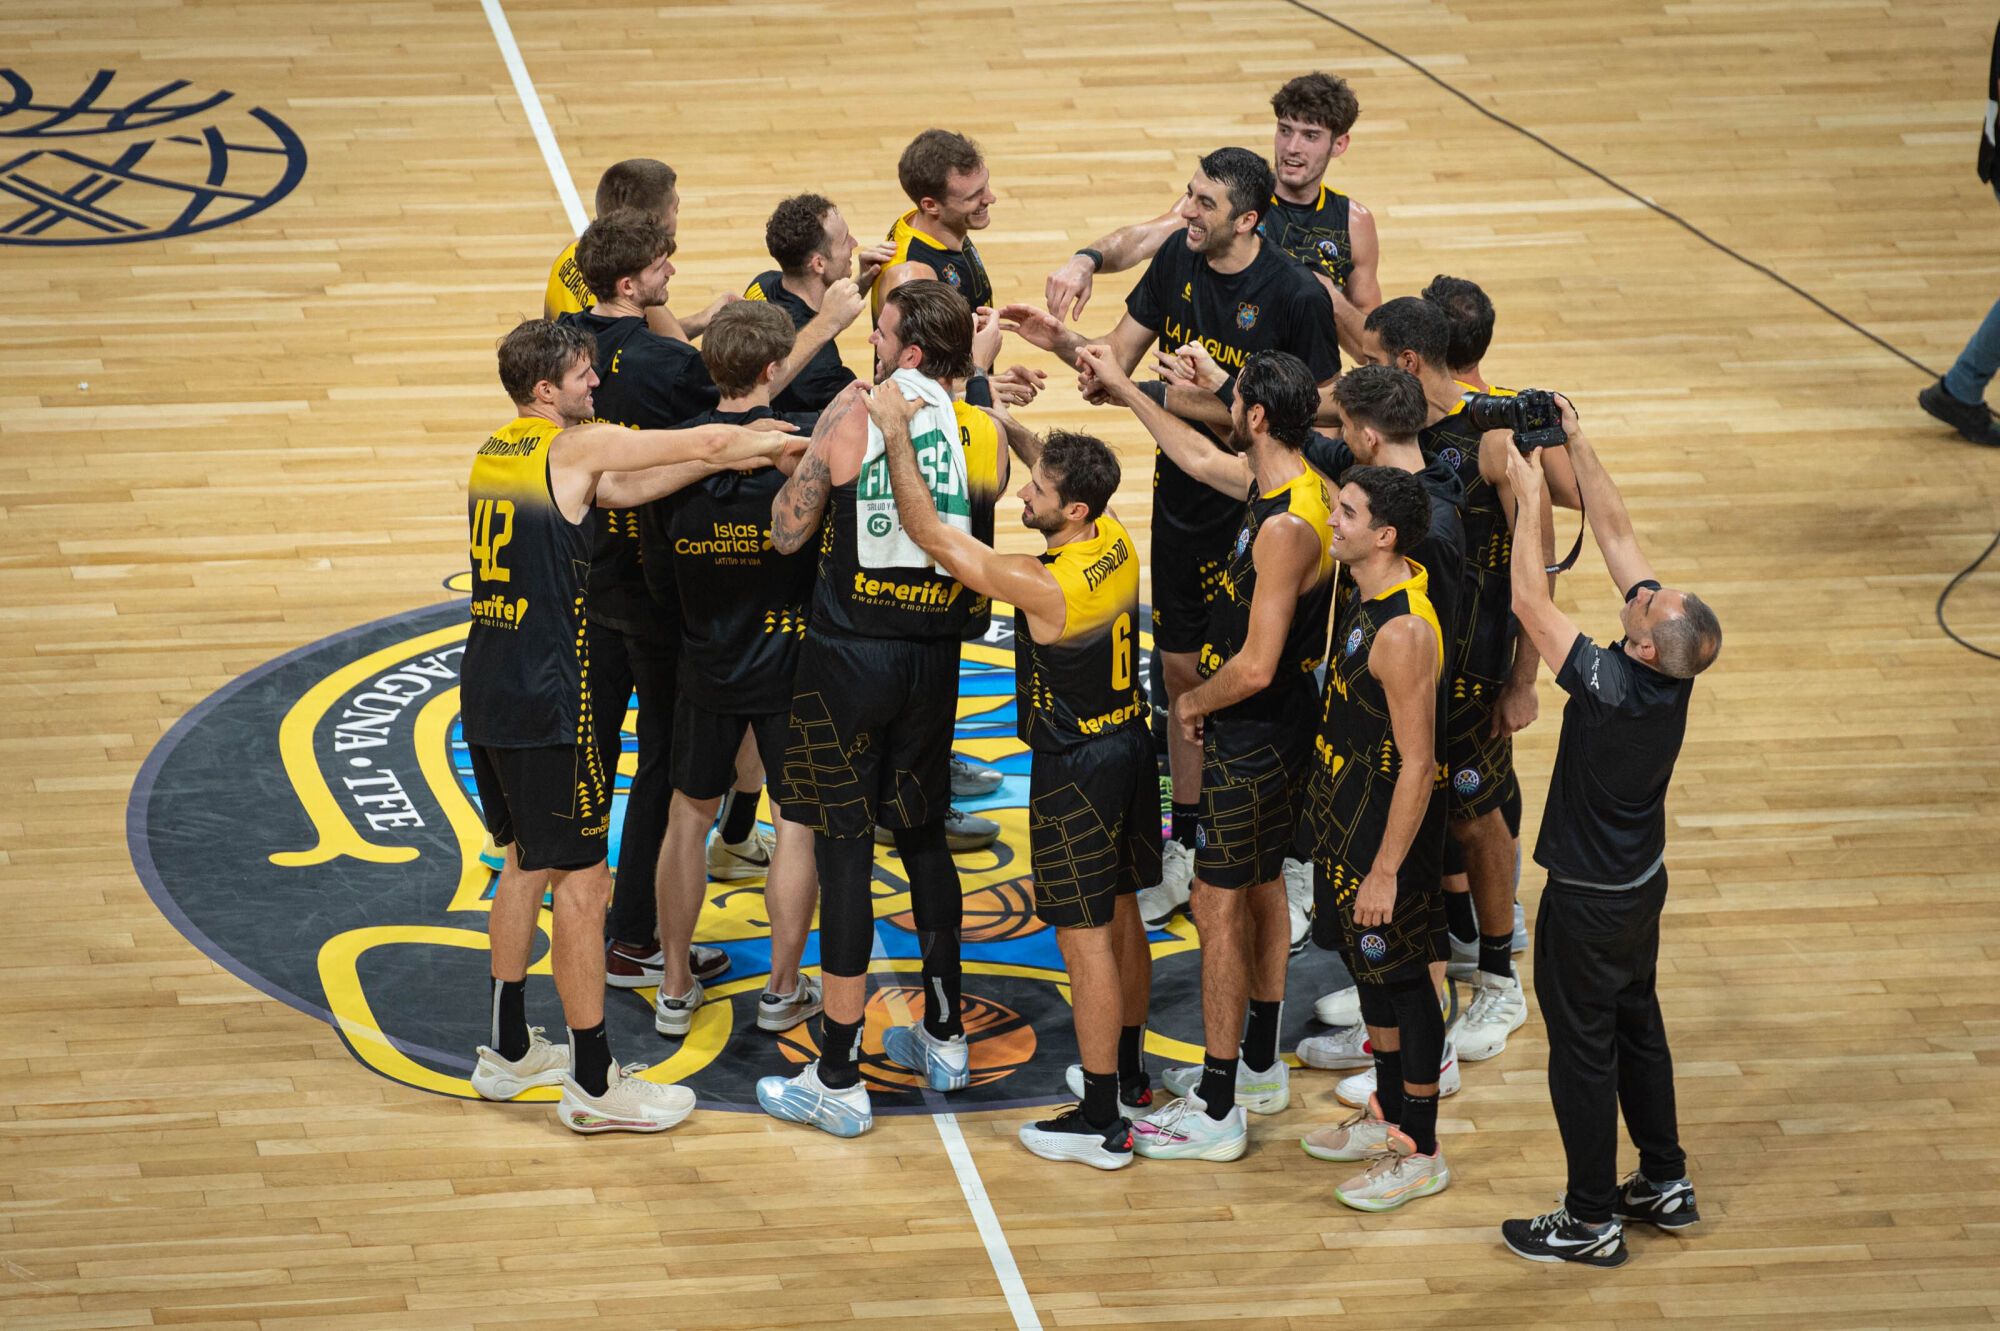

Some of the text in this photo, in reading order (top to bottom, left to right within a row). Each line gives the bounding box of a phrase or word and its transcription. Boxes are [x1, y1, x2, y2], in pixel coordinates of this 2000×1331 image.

[1165, 315, 1181, 343] LA
[867, 503, 886, 511] SALUD
[471, 499, 515, 582] 42
[713, 522, 758, 538] Islas
[675, 537, 760, 555] Canarias
[851, 593, 896, 606] awakens
[1111, 612, 1131, 691] 6
[342, 768, 425, 831] TFE
